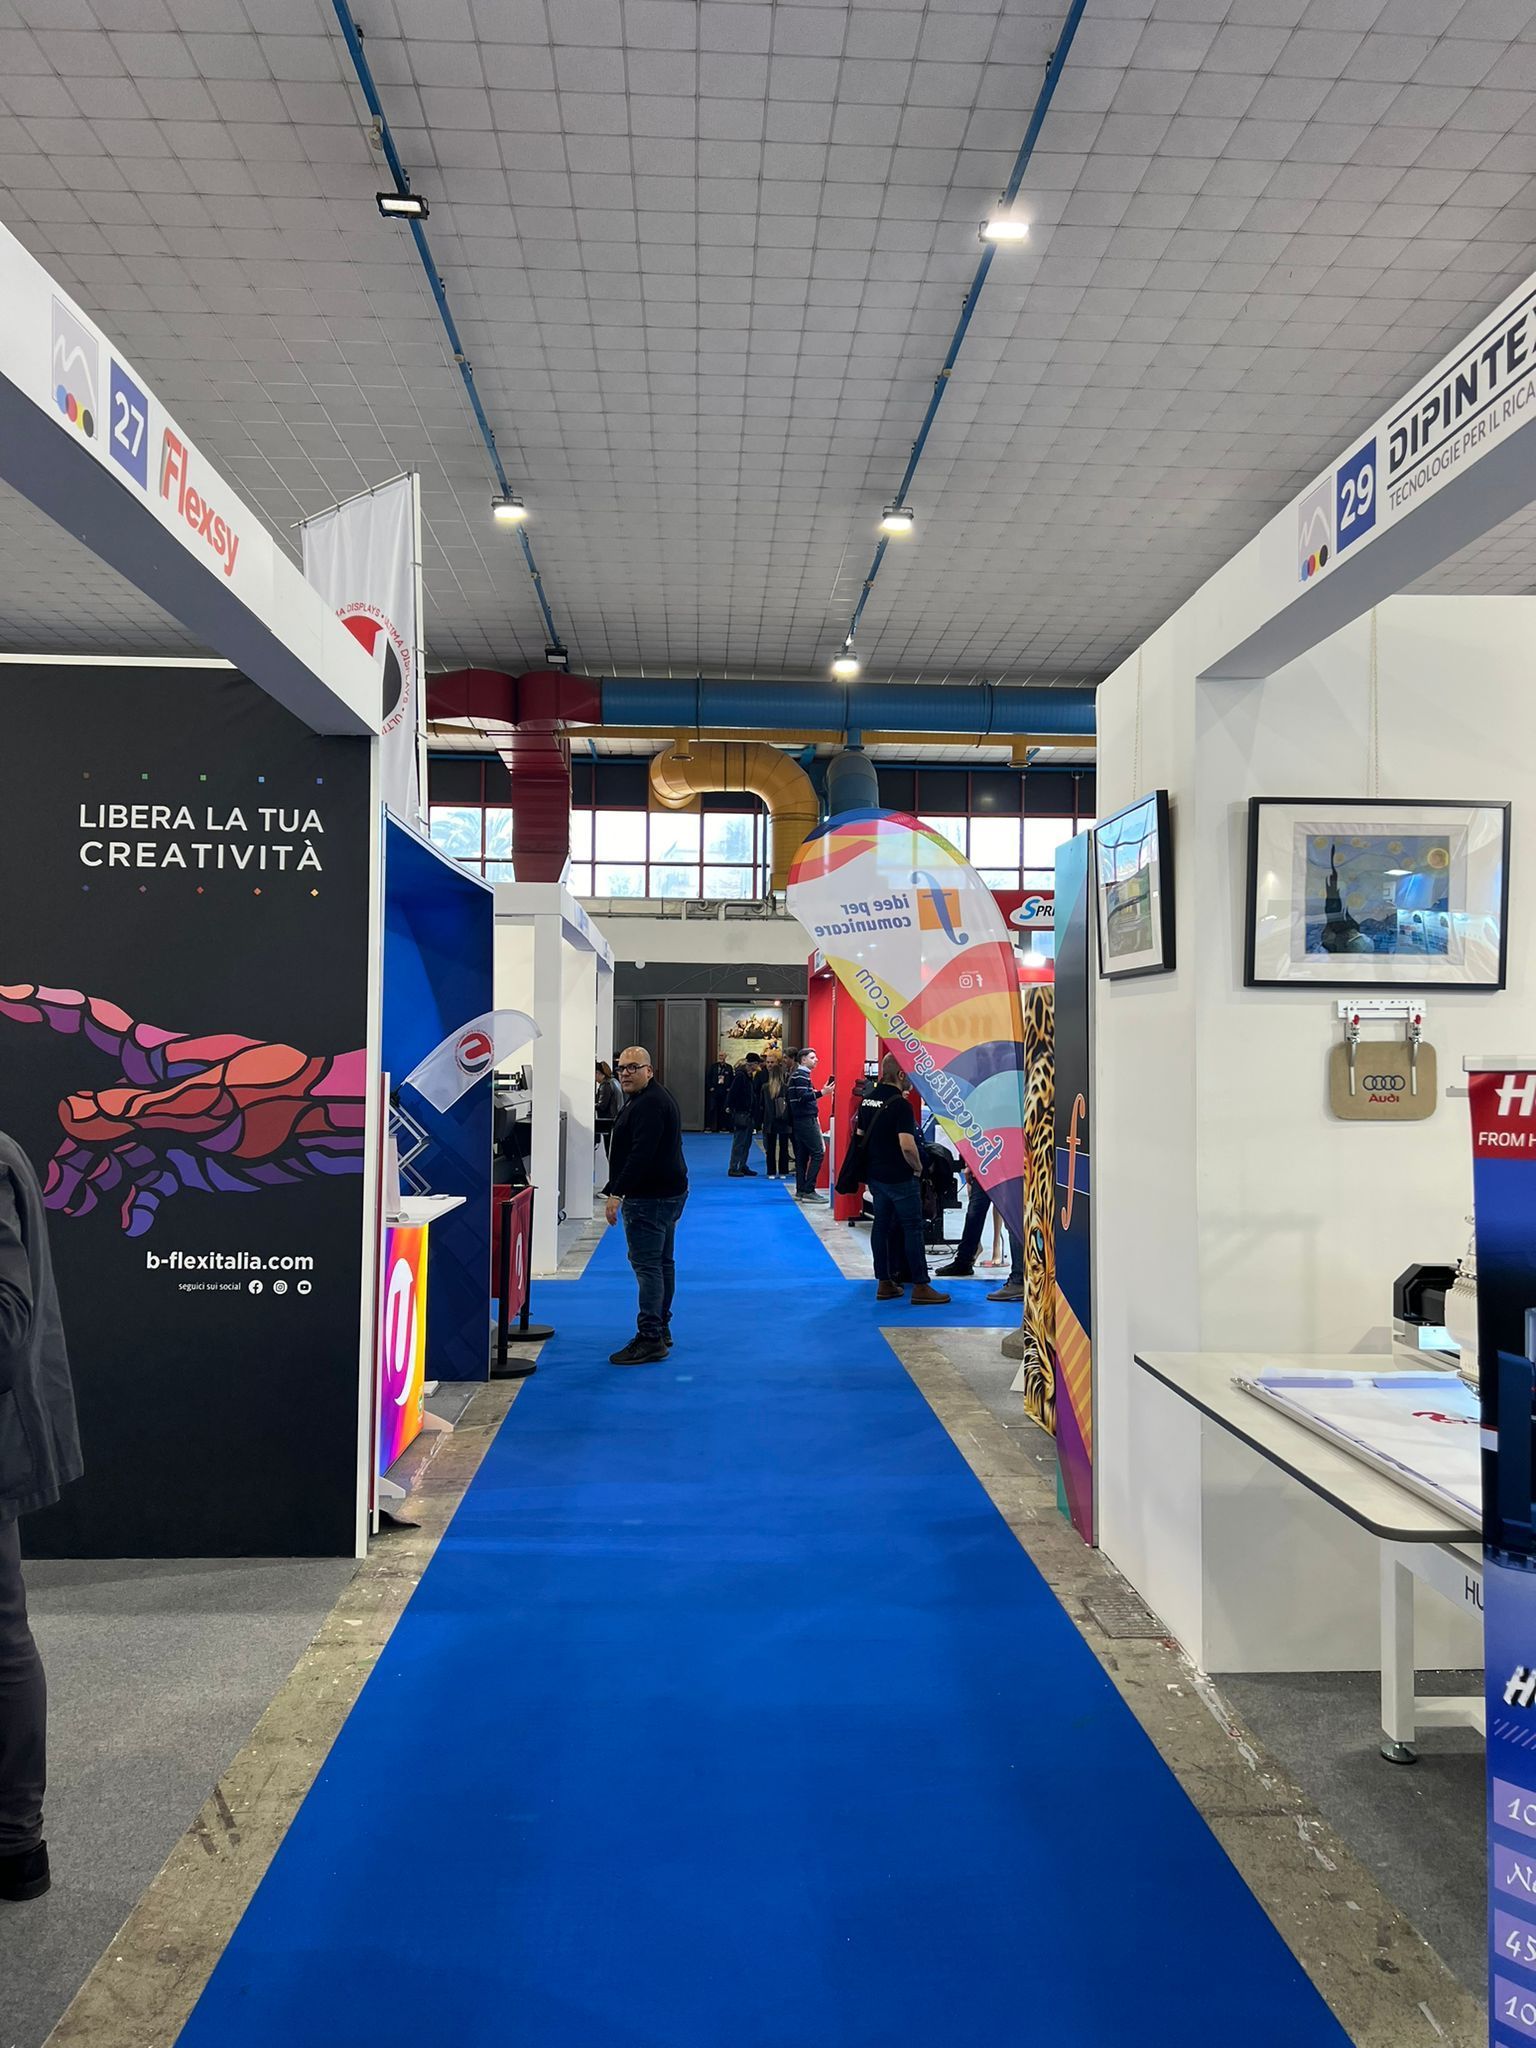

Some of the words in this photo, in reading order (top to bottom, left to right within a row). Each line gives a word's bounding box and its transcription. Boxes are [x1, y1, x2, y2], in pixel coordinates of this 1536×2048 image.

[1390, 304, 1536, 474] DIPINTE
[114, 391, 144, 458] 27
[1389, 438, 1461, 510] TECNOLOGIE
[1463, 420, 1486, 454] PER
[1489, 410, 1500, 433] IL
[159, 426, 239, 577] Flexsy
[1340, 463, 1374, 532] 29
[346, 602, 381, 617] DISPLAYS
[384, 617, 404, 648] ULTIMA
[79, 804, 195, 830] LIBERA
[207, 807, 248, 831] LA
[258, 808, 324, 833] TUA
[79, 839, 323, 871] CREATIVITÀ
[1368, 1094, 1400, 1103] Audi
[1478, 1131, 1525, 1147] FROM
[146, 1251, 314, 1270] b-flexitalia.com
[178, 1282, 205, 1292] seguici
[206, 1282, 218, 1291] sui
[219, 1282, 241, 1291] social
